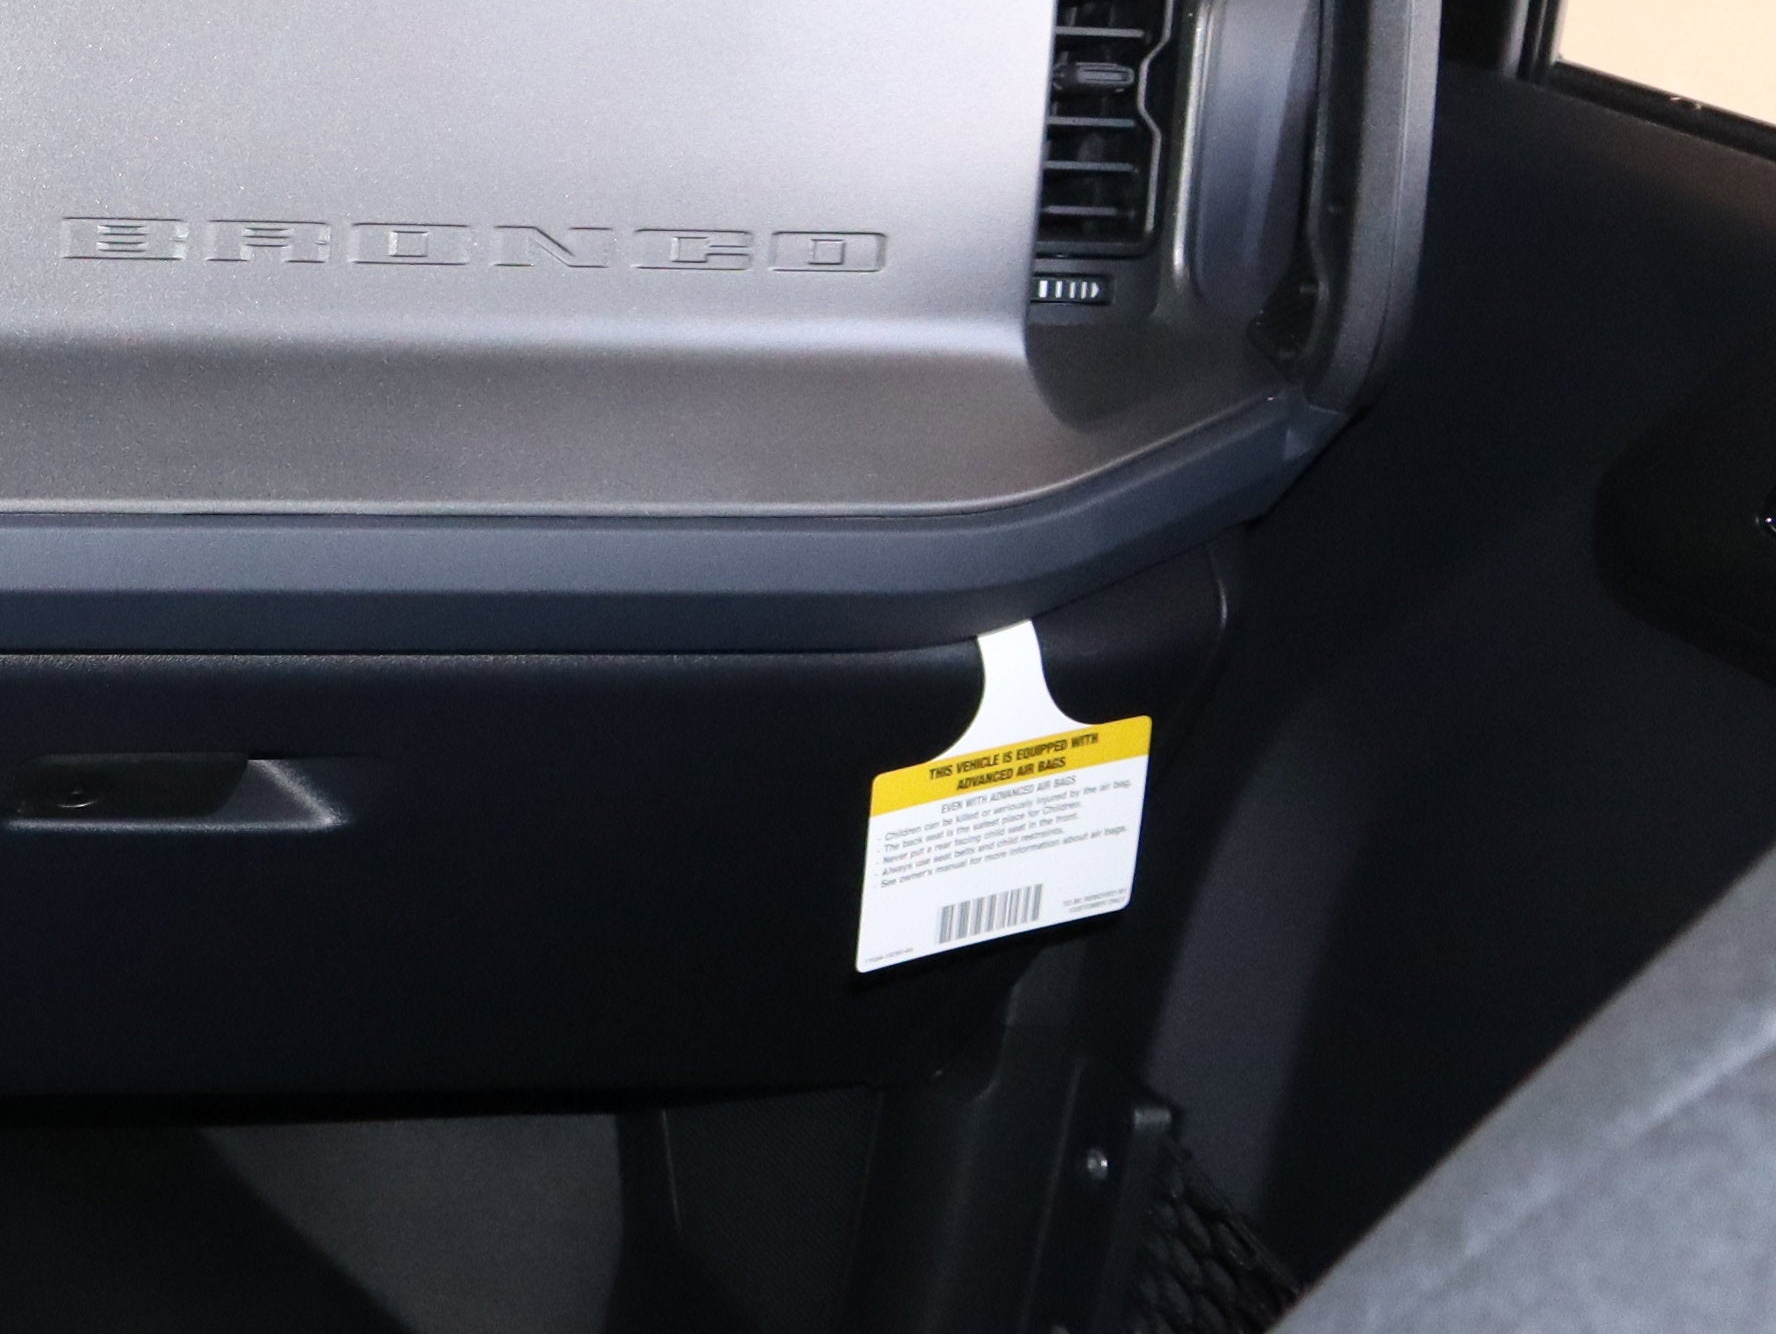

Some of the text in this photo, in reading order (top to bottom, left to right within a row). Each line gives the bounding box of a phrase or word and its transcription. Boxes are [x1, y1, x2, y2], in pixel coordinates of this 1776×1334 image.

[61, 216, 888, 273] BRONCO
[930, 733, 1099, 780] THIS VEHICLE IS EQUIPPED WITH
[957, 756, 1066, 790] ADVANCED AIR BAGS
[990, 784, 1034, 801] ADVANCED
